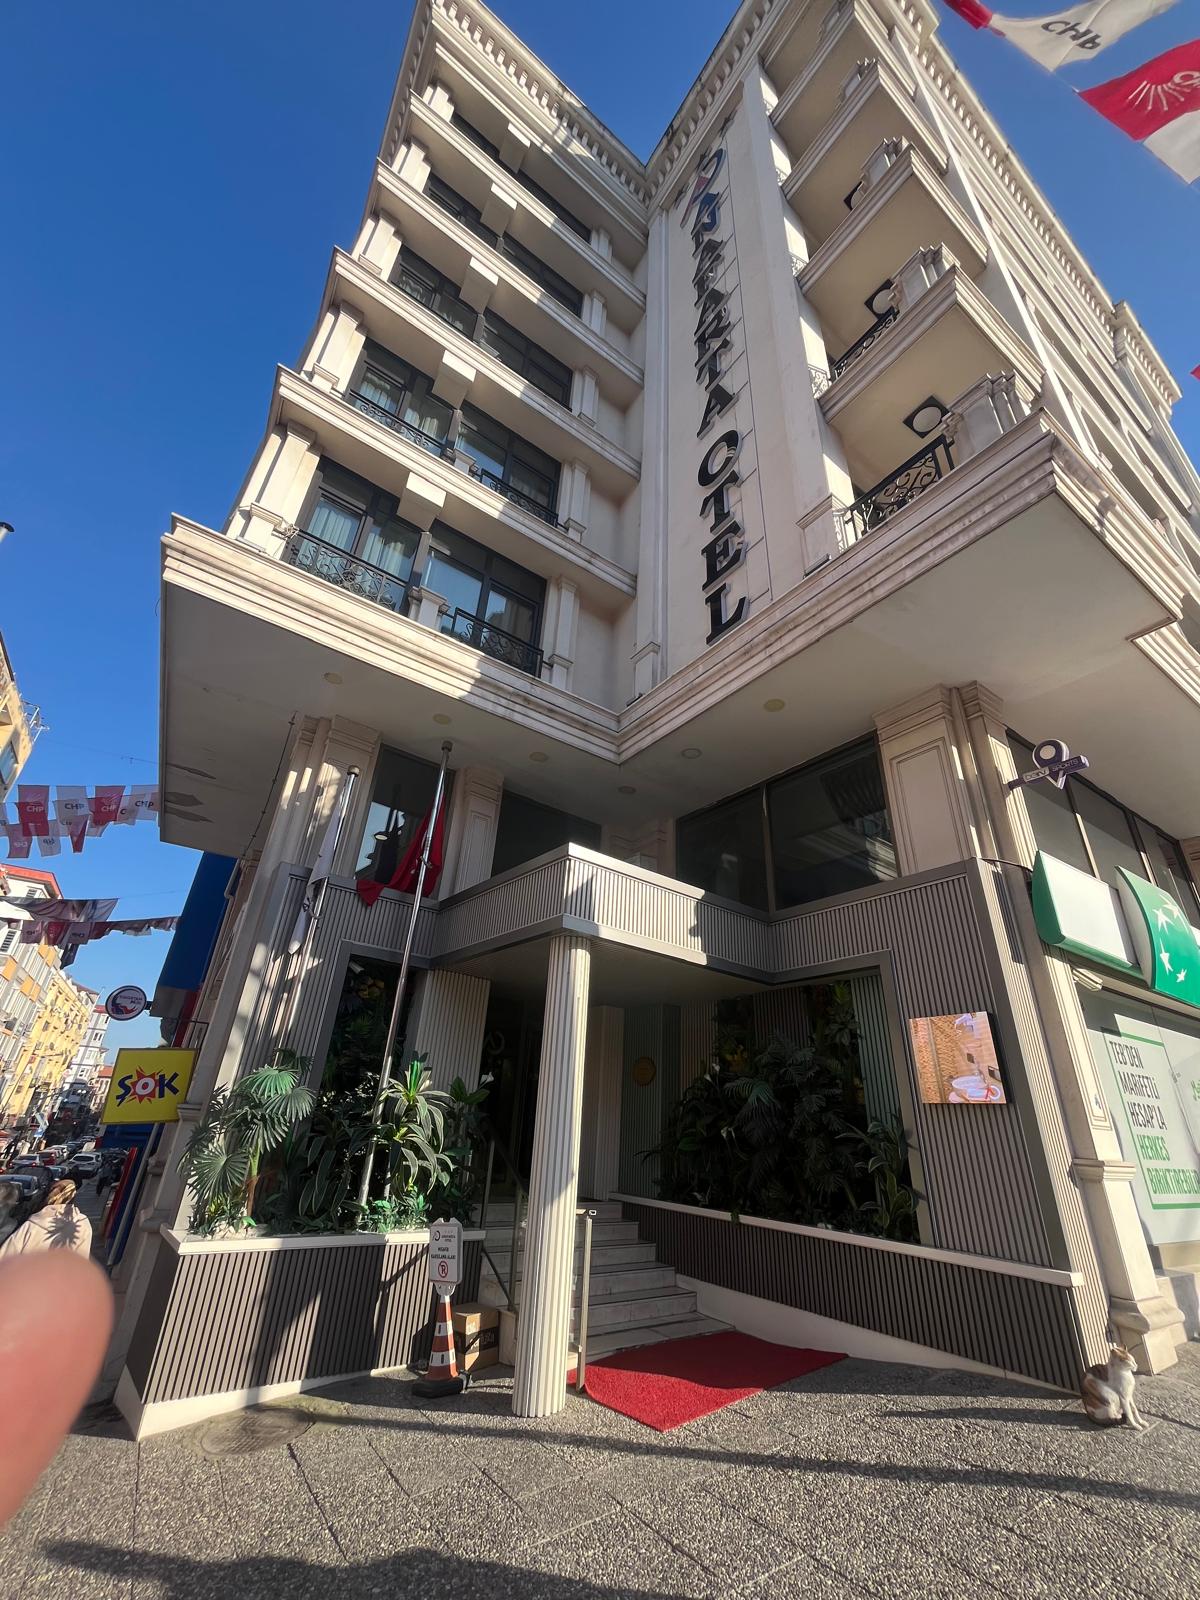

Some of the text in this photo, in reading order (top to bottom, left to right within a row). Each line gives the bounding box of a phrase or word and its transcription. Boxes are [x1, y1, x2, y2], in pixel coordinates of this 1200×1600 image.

[691, 192, 750, 647] ANAFARTA OTEL
[1051, 758, 1079, 772] SPORTS
[64, 802, 85, 810] CHP
[101, 804, 117, 812] CHP
[134, 800, 154, 808] CHP
[1109, 1040, 1144, 1069] TEB'DEN
[116, 1072, 179, 1107] ŞOK
[1118, 1070, 1161, 1100] MARİFETLİ
[1127, 1101, 1168, 1130] HESAP'LA
[1136, 1134, 1170, 1161] HERKES
